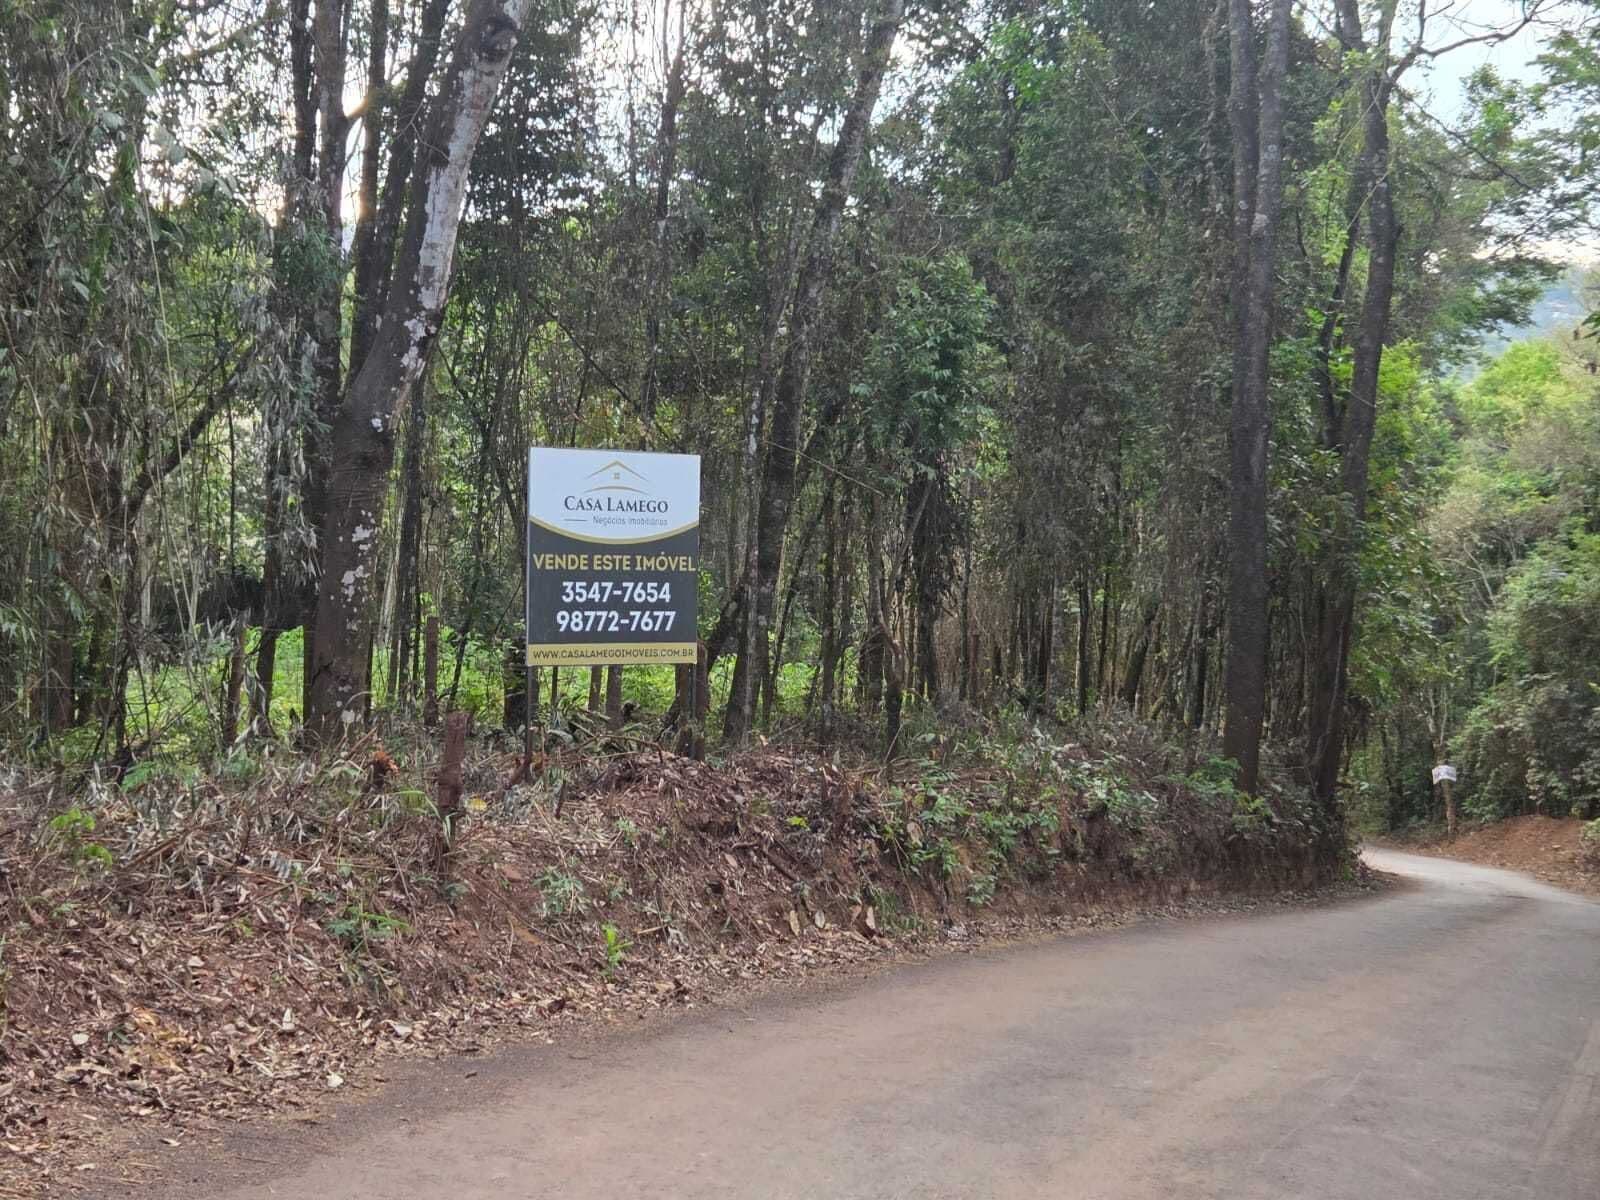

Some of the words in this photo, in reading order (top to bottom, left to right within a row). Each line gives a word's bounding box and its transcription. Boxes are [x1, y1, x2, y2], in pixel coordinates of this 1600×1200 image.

[564, 495, 603, 511] CASA
[607, 497, 669, 513] LAMEGO
[533, 553, 589, 570] VENDE
[593, 554, 631, 571] ESTE
[635, 551, 696, 572] IMÓVEL
[561, 581, 671, 603] 3547-7654
[556, 610, 676, 632] 98772-7677
[533, 647, 694, 659] WWW.CASALAMEGOIMOVEIS.COM.BR
